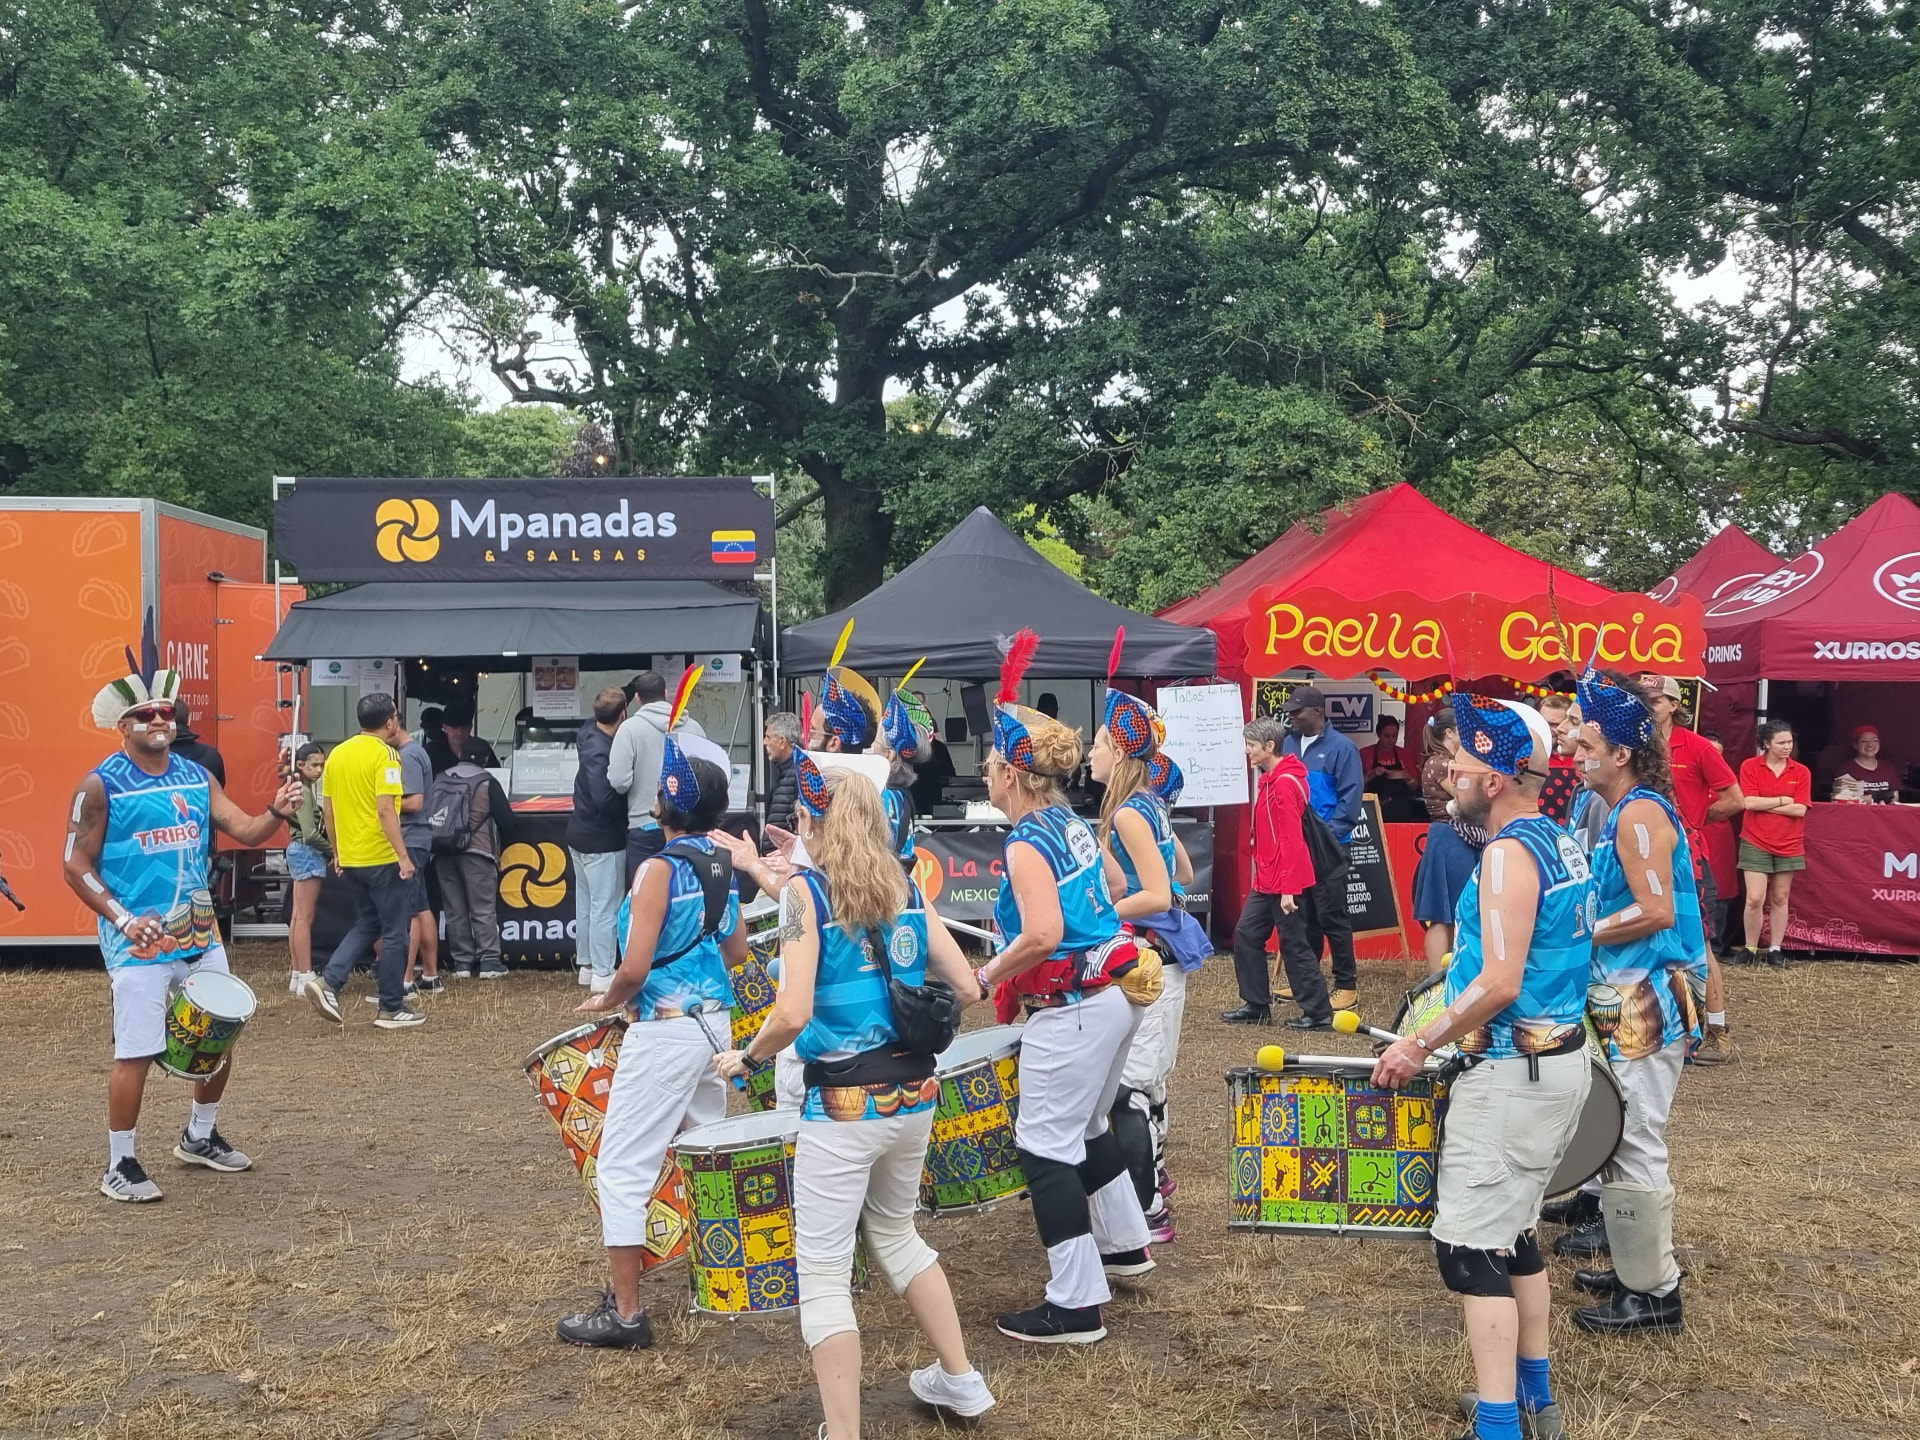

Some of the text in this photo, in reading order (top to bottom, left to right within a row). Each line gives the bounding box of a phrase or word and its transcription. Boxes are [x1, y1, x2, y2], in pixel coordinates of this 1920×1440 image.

[450, 498, 678, 552] Mpanadas
[485, 549, 646, 562] & SALSAS
[1264, 603, 1686, 665] Paella Garcia
[166, 639, 209, 681] CARNE
[1708, 643, 1742, 663] DRINKS
[1813, 640, 1920, 661] XURROS
[1325, 696, 1368, 718] CW
[134, 824, 200, 848] TRIBO
[948, 856, 978, 877] La
